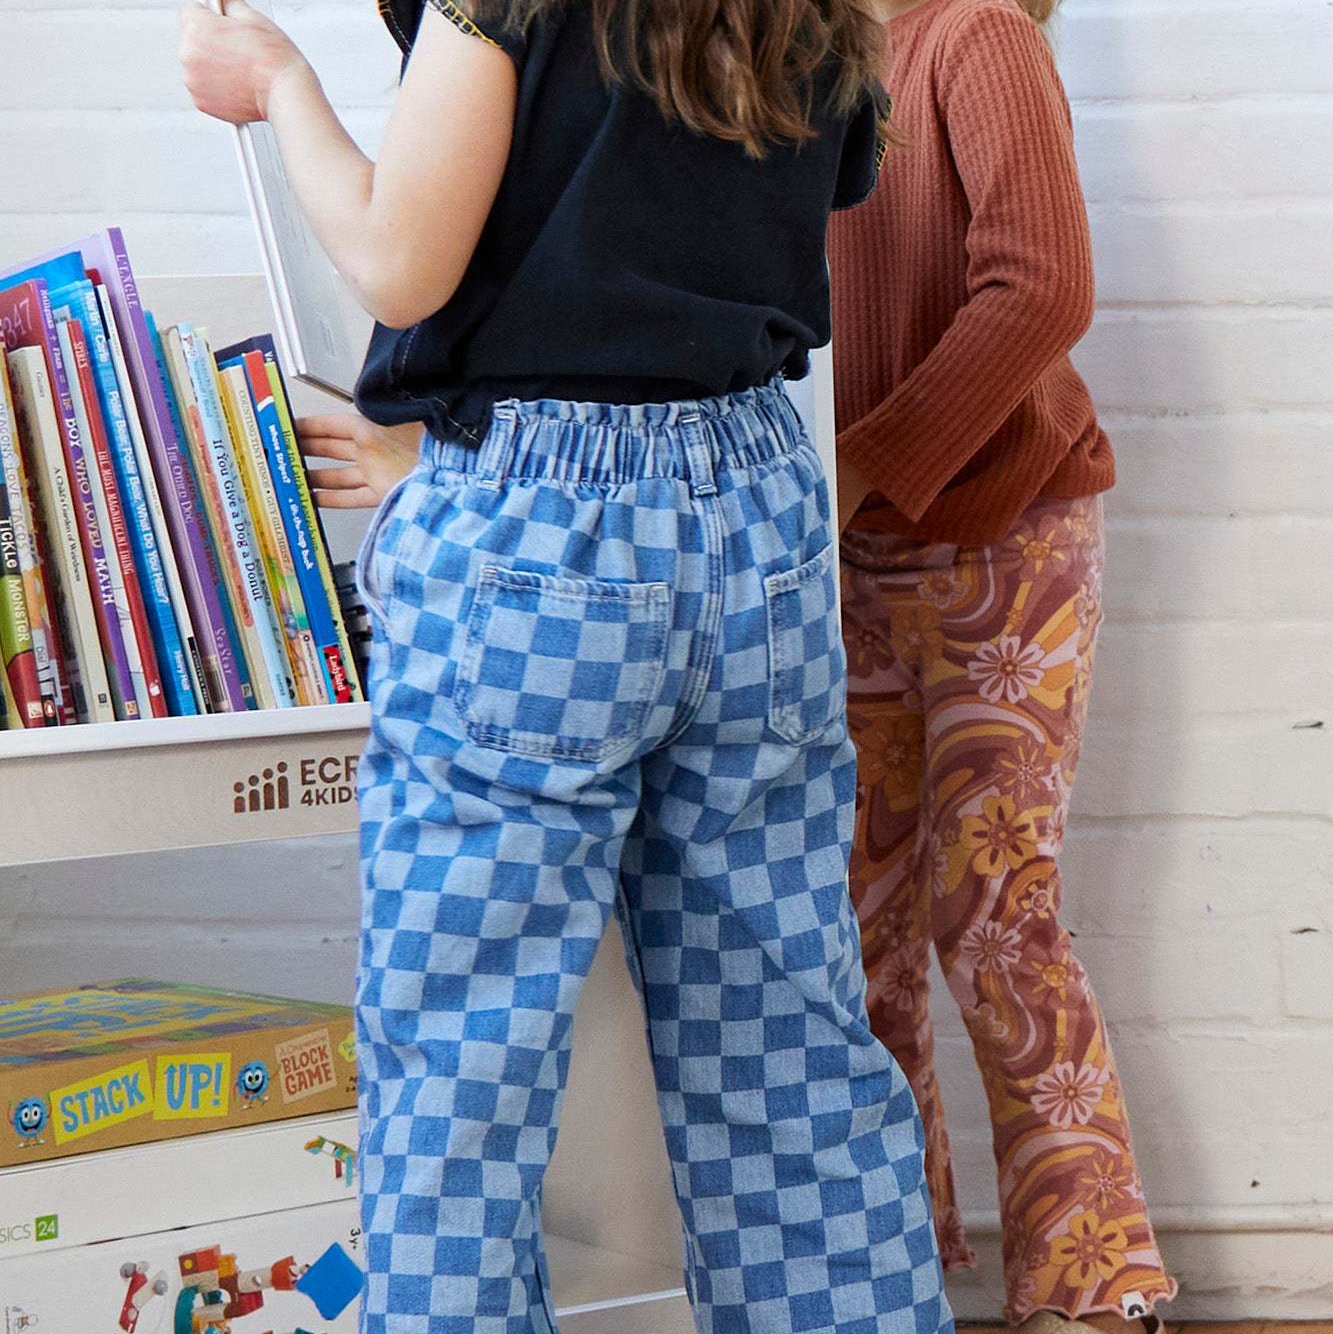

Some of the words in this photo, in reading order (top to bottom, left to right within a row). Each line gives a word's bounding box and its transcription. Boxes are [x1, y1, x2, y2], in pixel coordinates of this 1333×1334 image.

[115, 251, 139, 308] L'ENGLE
[38, 288, 56, 330] Heiligman
[83, 289, 102, 327] Martin
[93, 333, 111, 364] Carle
[51, 345, 64, 370] Pham
[107, 389, 124, 418] Polar
[238, 388, 257, 437] COUNTING
[63, 416, 82, 449] BOY
[212, 438, 223, 449] If
[267, 423, 282, 451] Whose
[282, 429, 294, 451] How
[97, 449, 110, 466] THE
[121, 445, 138, 475] Polar
[250, 436, 263, 460] TINY
[288, 451, 297, 463] to
[52, 465, 61, 475] A
[72, 455, 92, 495] WHO
[100, 467, 115, 491] MOST
[216, 453, 231, 476] You
[256, 460, 271, 489] DINOS
[274, 451, 291, 485] Stripes?
[291, 463, 305, 490] Catch
[7, 465, 20, 498] LOVE
[54, 474, 69, 503] Child's
[223, 479, 238, 508] Give
[59, 502, 74, 533] Garden
[134, 502, 152, 532] What
[266, 495, 278, 515] GUY
[10, 505, 28, 551] TACOS
[83, 501, 102, 549] LOVED
[105, 492, 129, 549] MAGNIFICENT
[232, 521, 249, 548] Dog
[141, 532, 156, 549] Do
[271, 515, 290, 564] GILCHRIST
[67, 543, 81, 582] Weirdness
[118, 549, 134, 575] THING
[146, 549, 161, 572] You
[300, 548, 314, 570] book
[92, 555, 116, 606] MATH
[151, 571, 169, 605] Hear?
[244, 561, 263, 602] Donut
[172, 649, 186, 674] Henry
[179, 674, 190, 691] Holt
[327, 654, 346, 692] Ladybird
[301, 786, 358, 806] 4KID
[281, 1045, 329, 1075] BLOCK
[284, 1063, 333, 1095] GAME
[59, 1073, 146, 1134] STACK
[163, 1062, 224, 1111] UP!
[38, 1220, 57, 1237] 24
